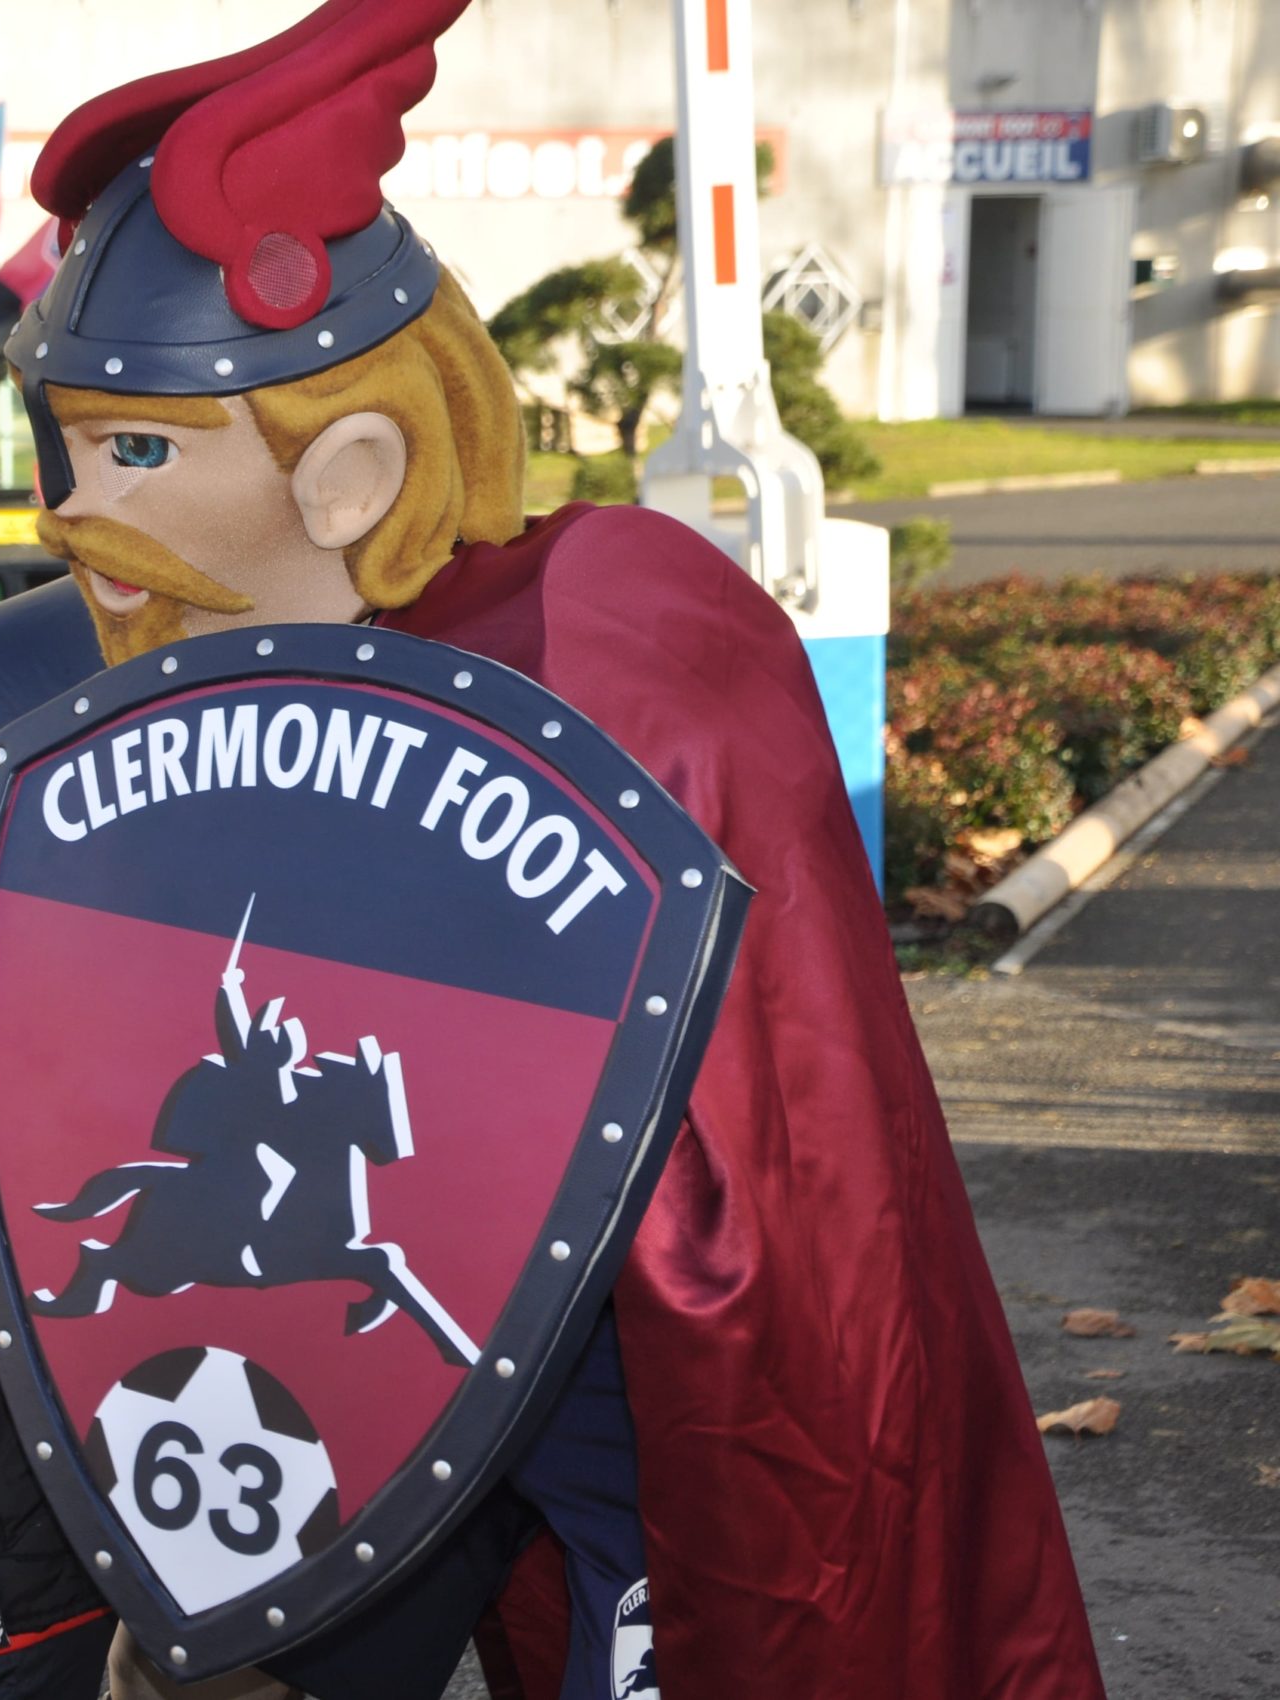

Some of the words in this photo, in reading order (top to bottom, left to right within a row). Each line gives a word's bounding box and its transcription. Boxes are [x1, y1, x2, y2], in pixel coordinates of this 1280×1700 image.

[42, 703, 428, 842] CLERMONT
[420, 746, 627, 935] FOOT
[133, 1421, 283, 1556] 63
[622, 1586, 650, 1616] CLER
